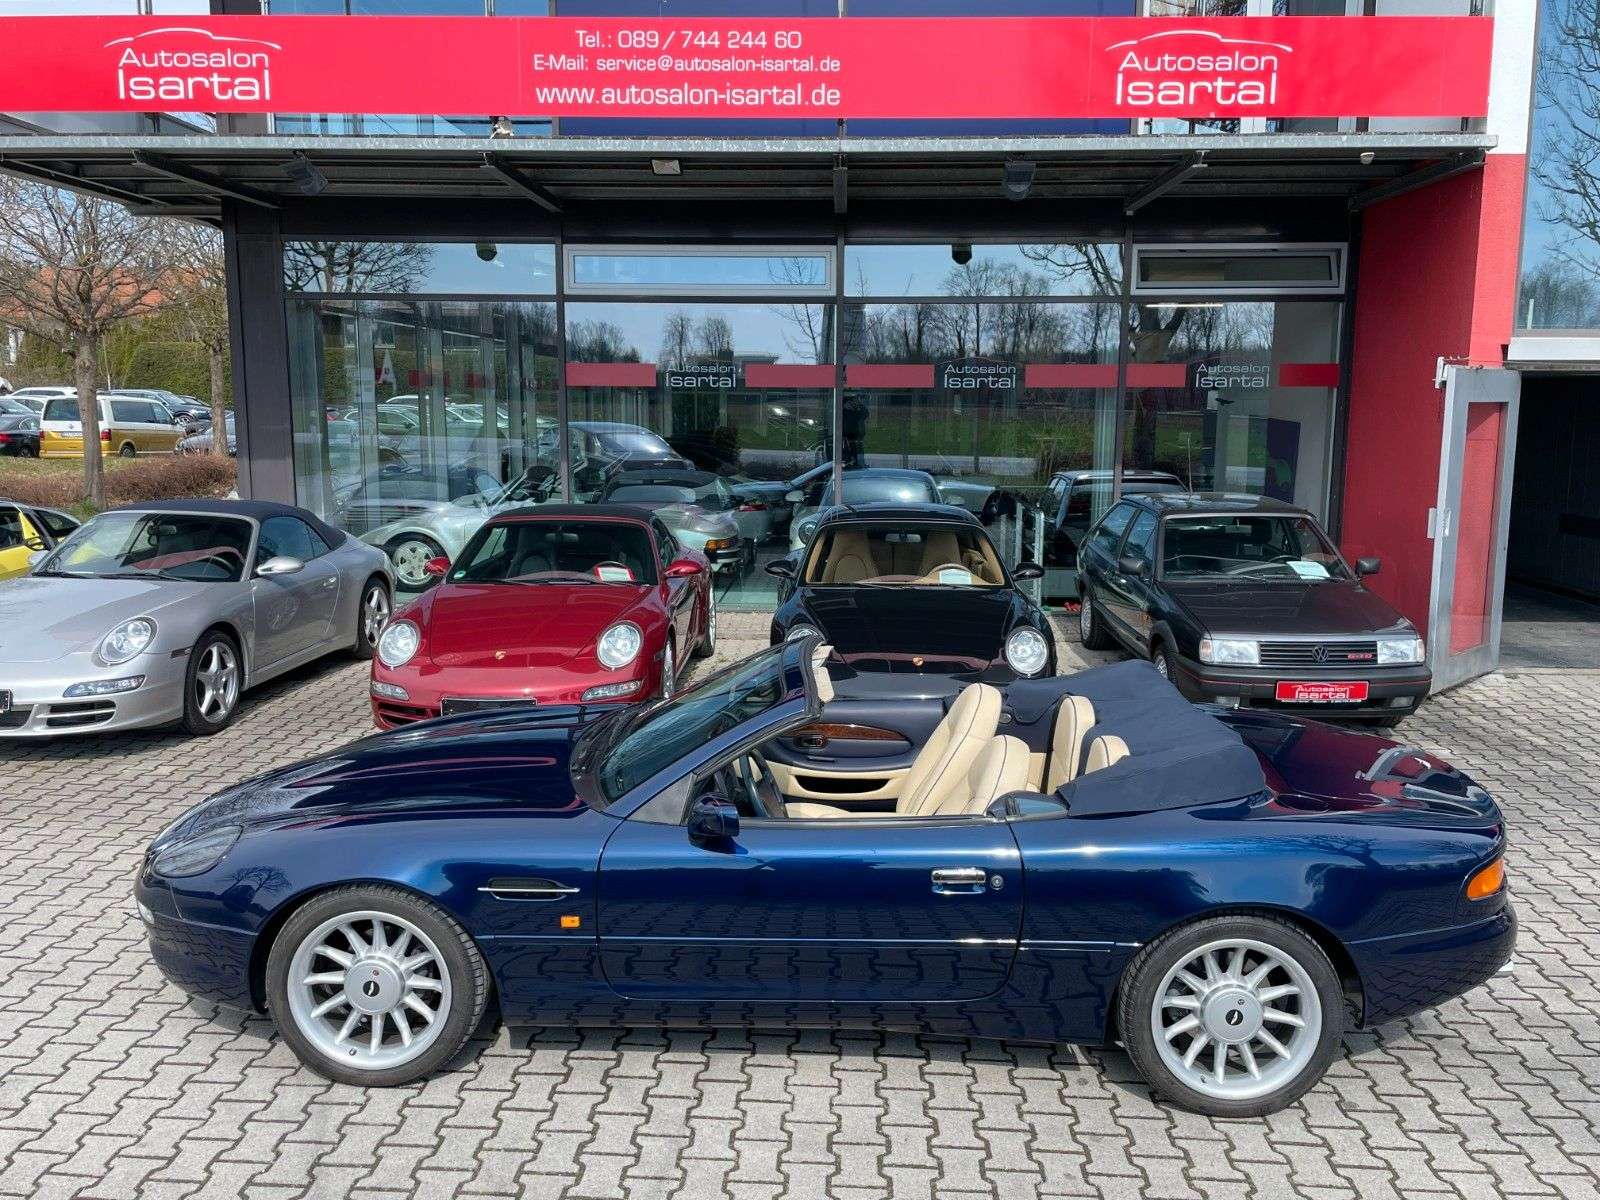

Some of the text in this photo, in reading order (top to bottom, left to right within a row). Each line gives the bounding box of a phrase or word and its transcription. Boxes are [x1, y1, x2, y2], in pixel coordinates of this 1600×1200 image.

[576, 30, 612, 49] Tel.:
[681, 31, 720, 49] 744
[727, 31, 767, 49] 244
[774, 31, 802, 49] 60
[118, 47, 269, 68] Autosalon
[533, 54, 841, 72] E-Mail: service@autosalon-isartal.de
[1119, 51, 1278, 72] Autosalon
[118, 69, 271, 100] Isartal
[1116, 72, 1278, 105] Isartal
[536, 82, 841, 106] www.autosalon-isartal.de
[666, 362, 736, 373] Autosalon
[944, 364, 1017, 374] Autosalon
[1197, 363, 1270, 373] Autosalon
[665, 373, 736, 388] Isartal
[944, 374, 1017, 388] Isartal
[1195, 372, 1270, 388] Isartal
